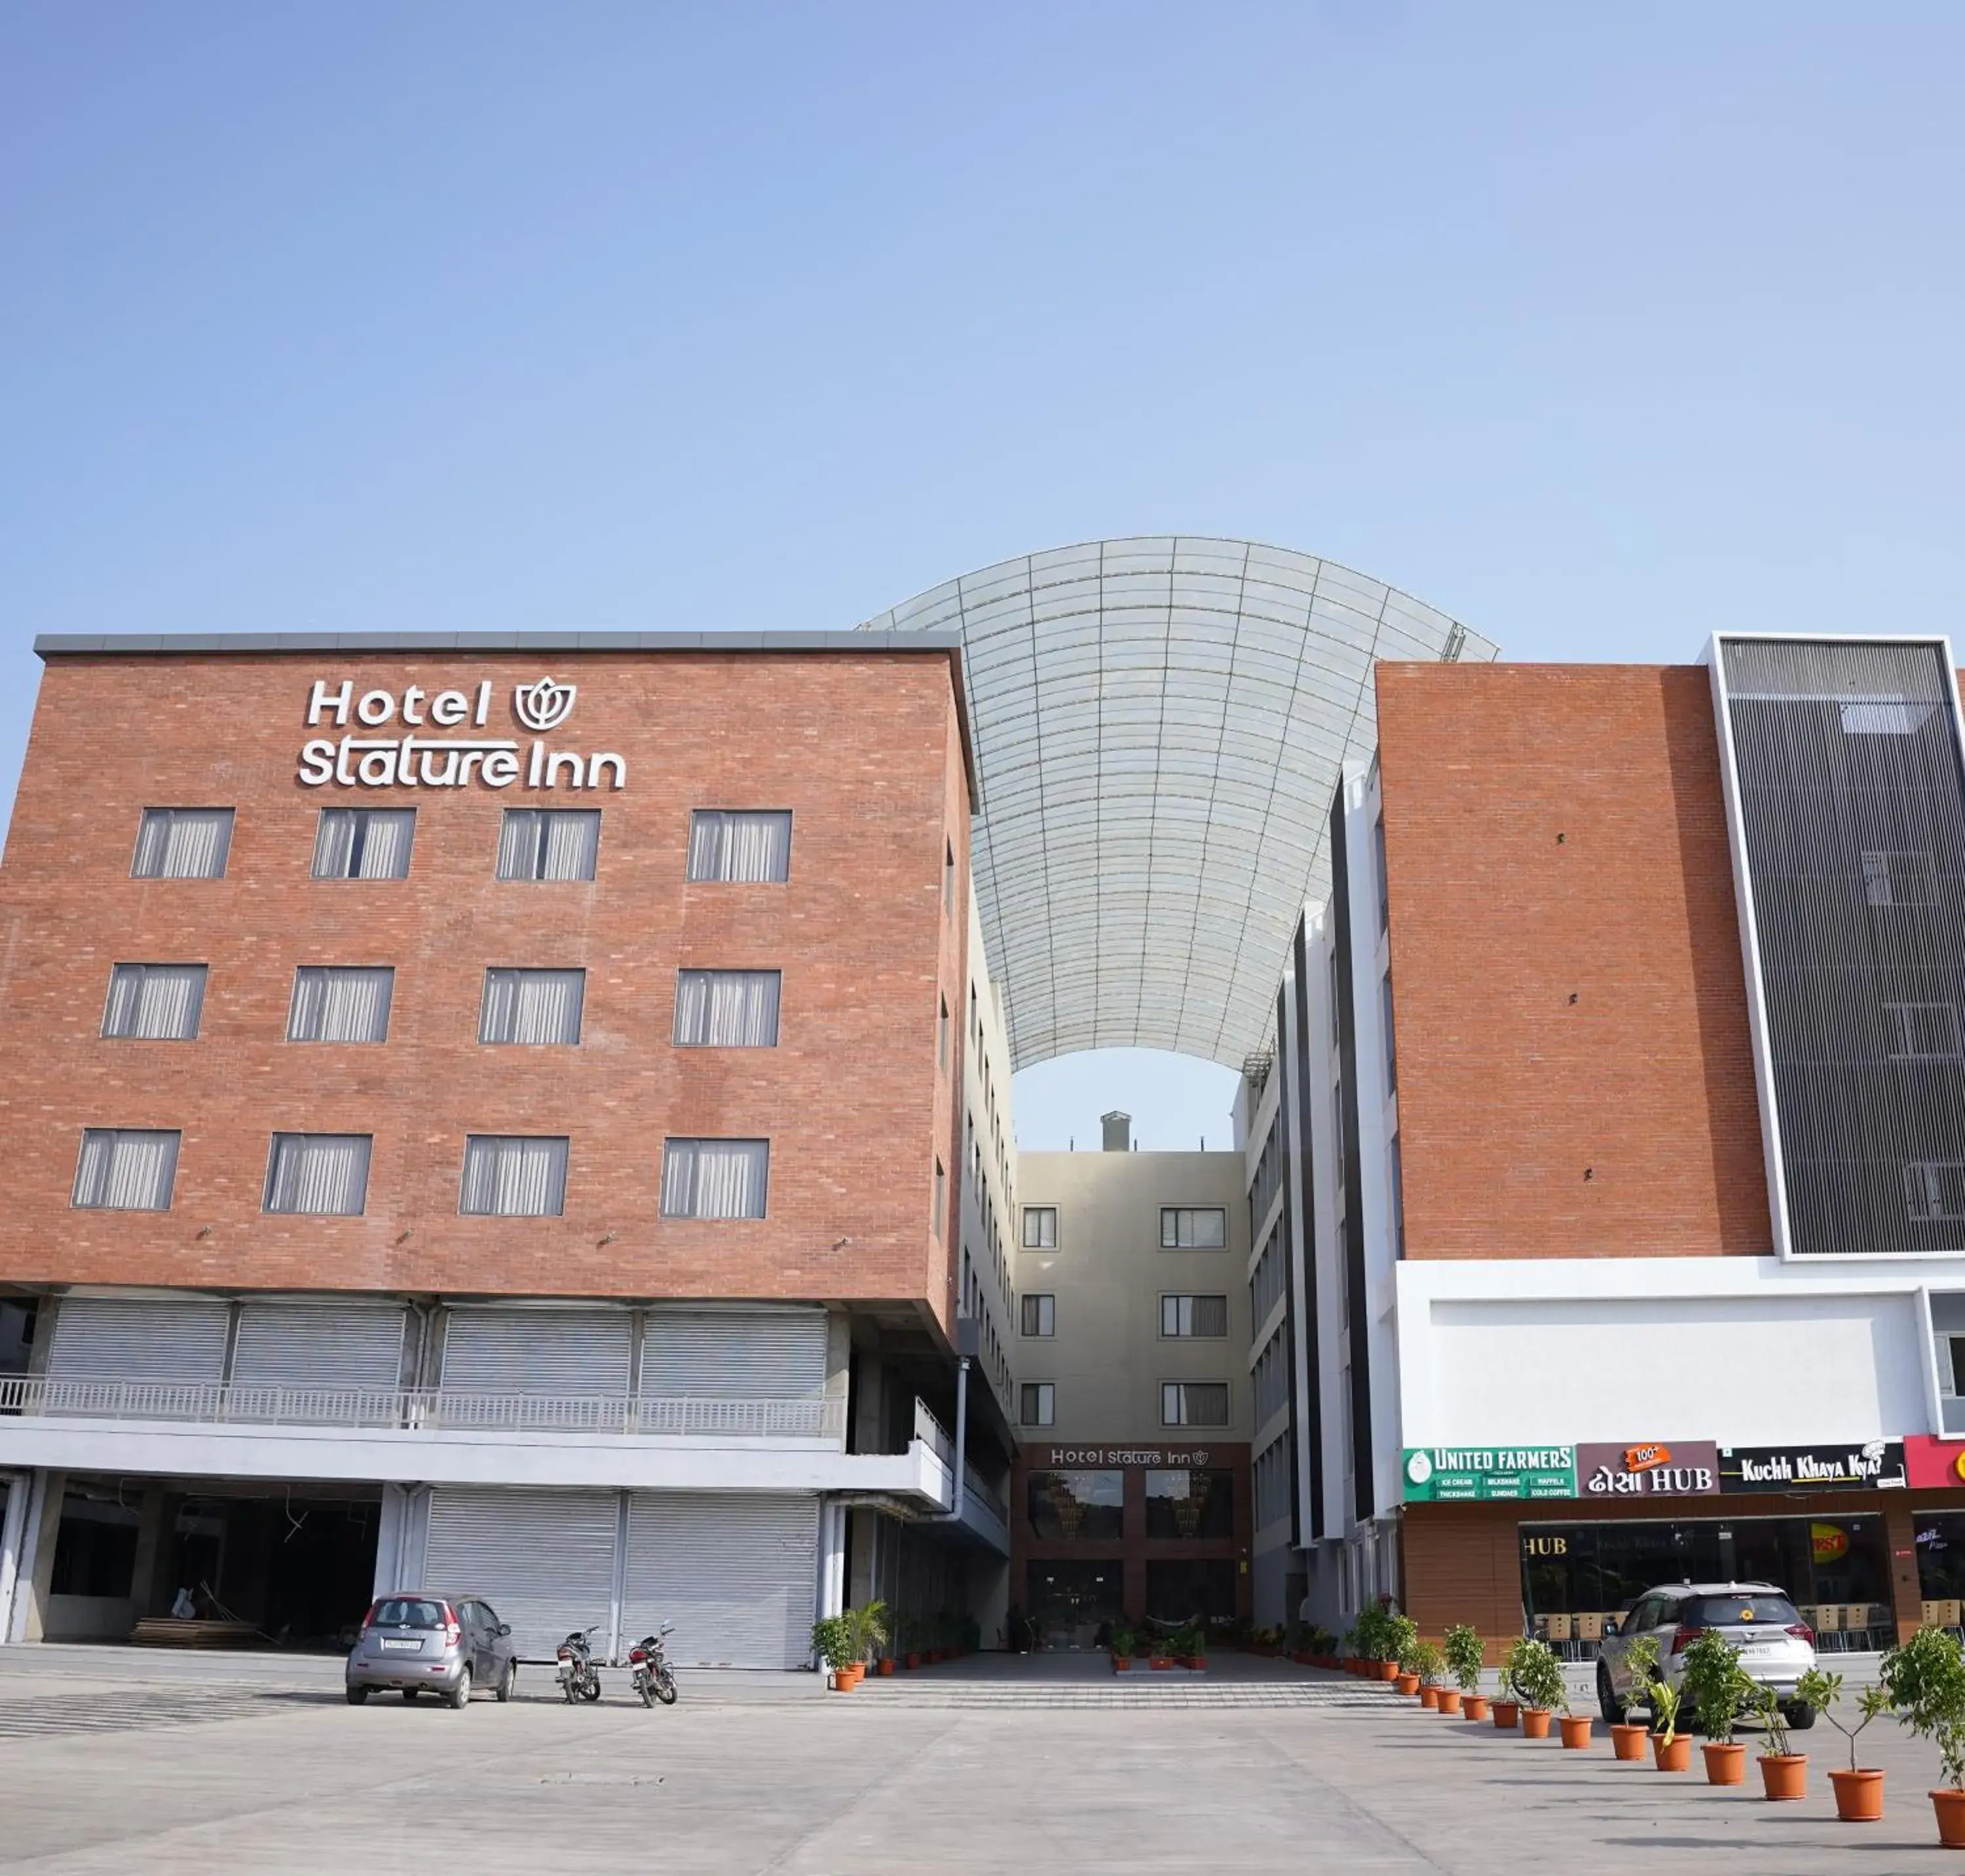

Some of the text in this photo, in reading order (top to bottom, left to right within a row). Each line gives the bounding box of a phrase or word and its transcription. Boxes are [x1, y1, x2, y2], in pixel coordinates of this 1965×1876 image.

[307, 680, 492, 726] Hotel
[299, 734, 627, 788] Stature Inn
[1051, 1449, 1191, 1465] Hotel Stature Inn
[1434, 1447, 1571, 1470] UNITED FARMERS
[1741, 1456, 1793, 1482] Kuchh
[1650, 1468, 1713, 1492] HUB
[1524, 1537, 1567, 1555] HUB
